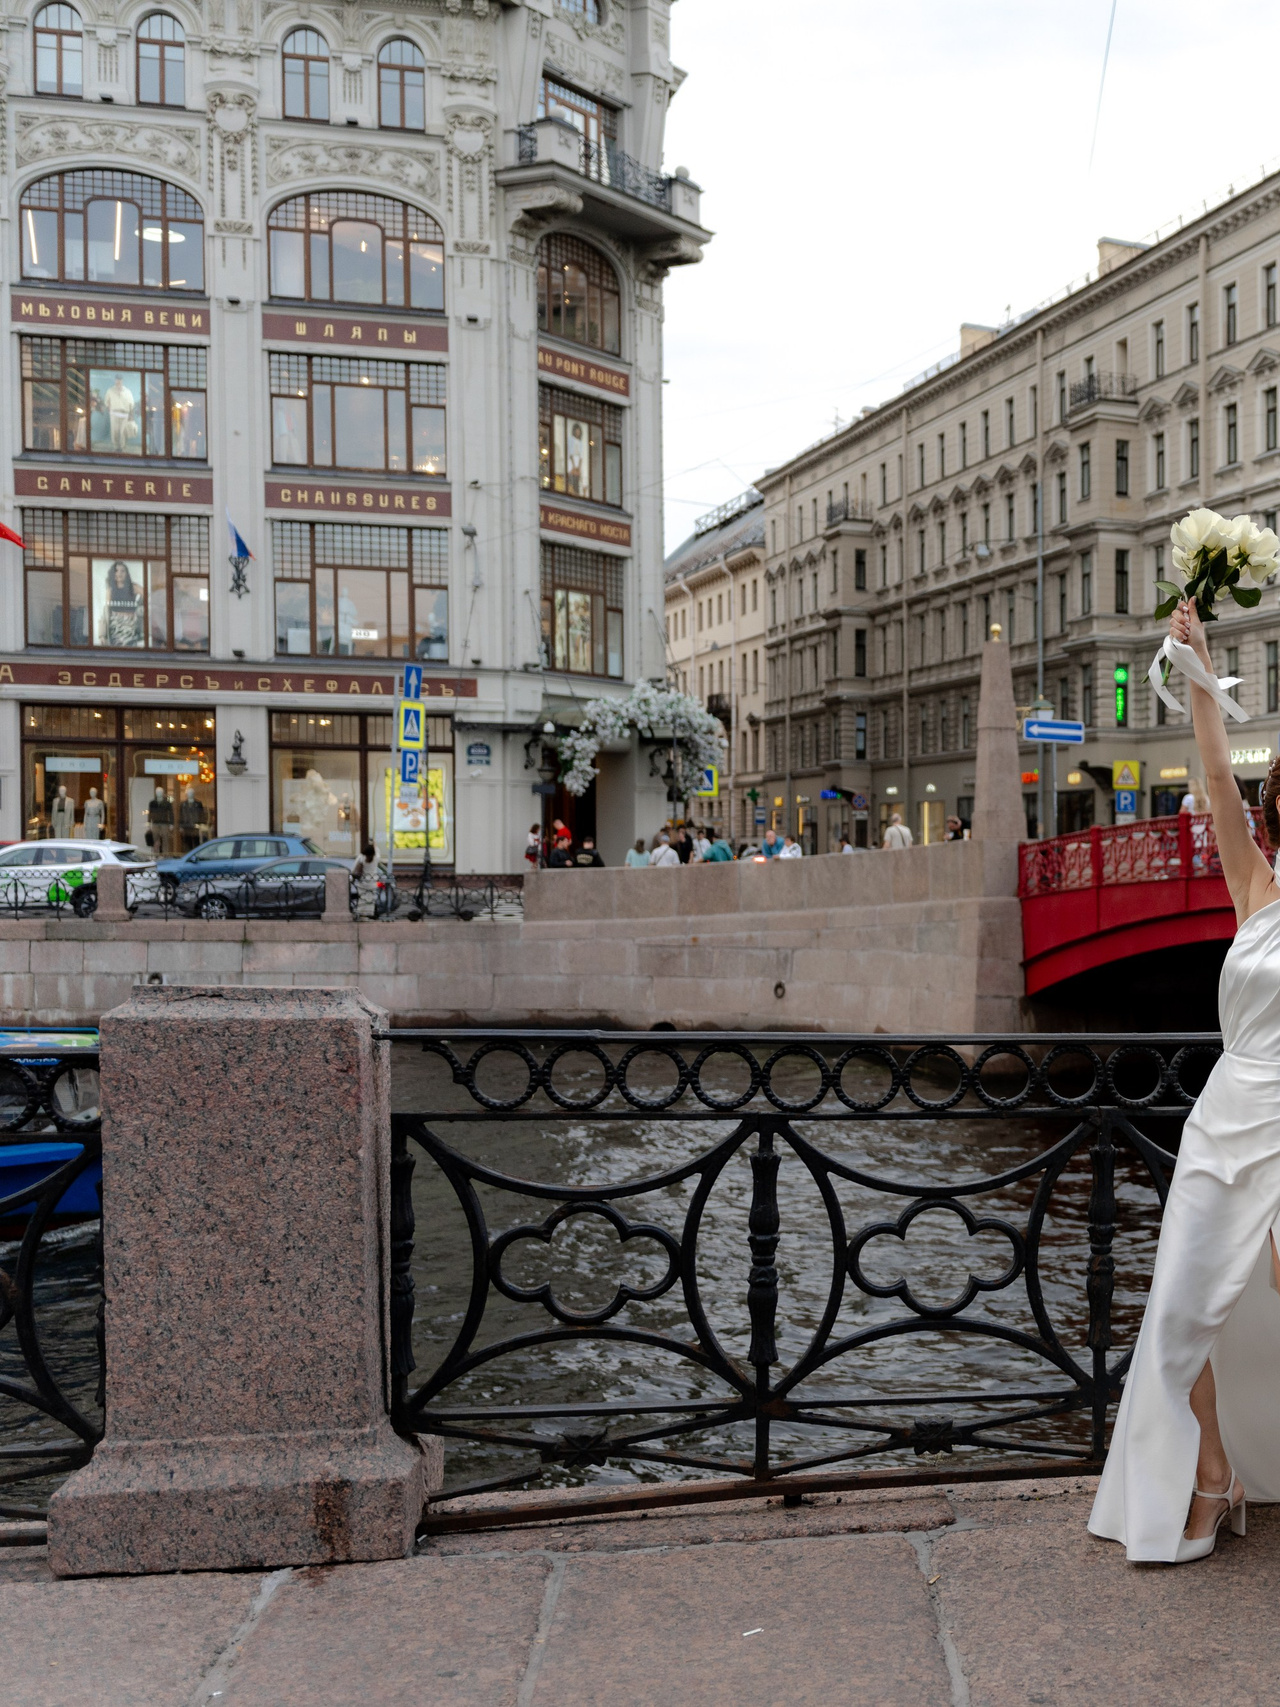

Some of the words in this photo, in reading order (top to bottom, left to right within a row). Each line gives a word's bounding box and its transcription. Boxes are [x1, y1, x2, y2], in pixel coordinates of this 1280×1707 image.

[144, 310, 202, 328] ВЕЩИ
[295, 321, 417, 344] ШЛЯПЫ
[556, 357, 586, 378] PONT
[589, 367, 627, 391] ROUGE
[281, 488, 438, 511] CHAUSSURES
[58, 671, 220, 690] ЭСДЕРСЪ
